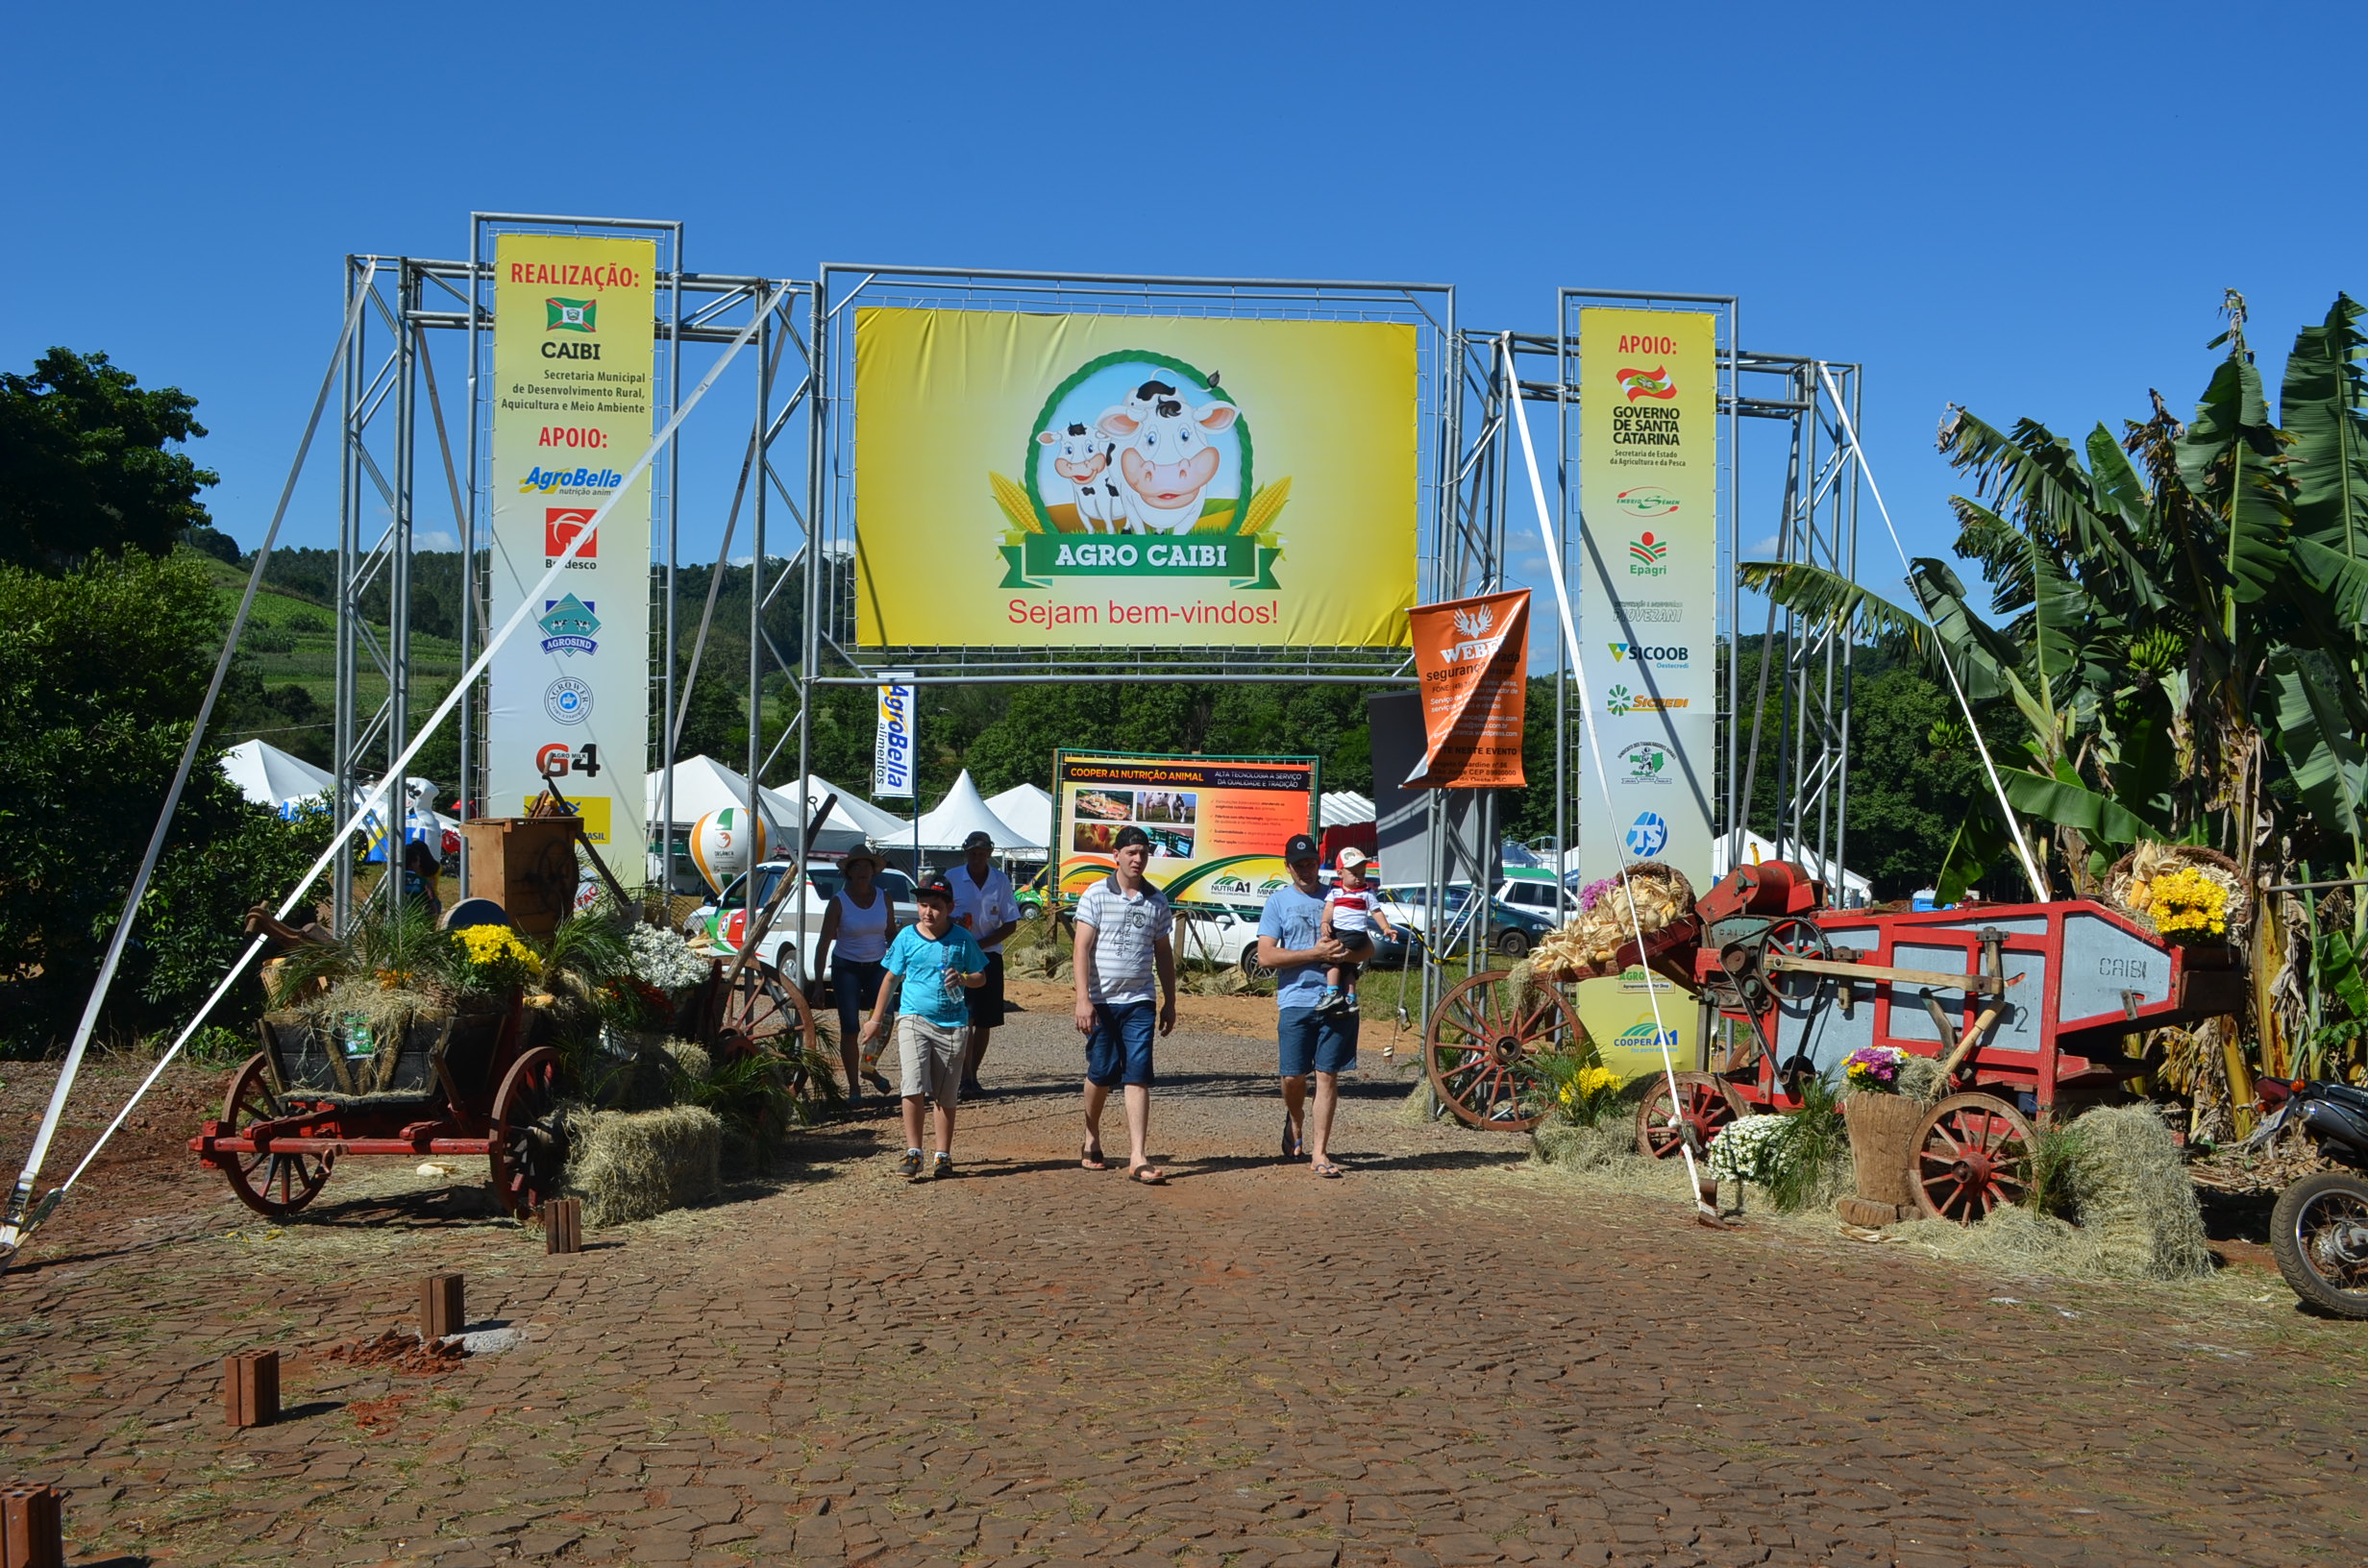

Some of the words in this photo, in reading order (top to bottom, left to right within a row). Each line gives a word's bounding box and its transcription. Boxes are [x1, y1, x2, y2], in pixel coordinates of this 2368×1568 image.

[510, 262, 640, 291] REALIZAÇÃO:
[541, 341, 601, 360] CAIBI
[1618, 334, 1677, 355] APOIO:
[544, 369, 595, 381] Secretaria
[597, 371, 646, 384] Municipal
[512, 383, 525, 393] de
[528, 383, 613, 397] Desenvolvimento
[615, 387, 645, 399] Rural,
[501, 399, 559, 410] Aquicultura
[562, 402, 568, 410] e
[571, 402, 595, 411] Meio
[597, 402, 645, 413] Ambiente
[1613, 406, 1680, 419] GOVERNO
[1613, 419, 1632, 431] DE
[1635, 420, 1680, 432] SANTA
[538, 427, 608, 449] APOIO:
[1613, 432, 1681, 446] CATARINA
[1615, 449, 1647, 457] Secretaria
[1618, 457, 1654, 466] Agricultura
[525, 467, 622, 490] AgroBella
[558, 488, 591, 497] nutrição
[1055, 544, 1139, 567] AGRO
[1147, 545, 1227, 568] CAIBI
[545, 559, 597, 570] Bdesco
[1630, 565, 1666, 576] Epagri
[1008, 600, 1098, 630] Sejam
[1108, 600, 1279, 625] bem-vindos!
[1613, 608, 1683, 623] PIOVEZANI
[547, 638, 592, 649] AGROSIND
[1440, 637, 1501, 664] WEBE
[1628, 647, 1689, 661] SICOOB
[884, 685, 909, 788] AgroBella
[876, 723, 887, 784] alimentos
[1486, 747, 1517, 755] EVENTO
[1071, 768, 1108, 777] COOPER
[1109, 770, 1120, 778] A1
[1121, 770, 1167, 782] NUTRIÇÃO
[1169, 772, 1204, 782] ANIMAL
[1632, 825, 1662, 847] TS
[1235, 882, 1250, 893] A1
[2099, 957, 2147, 980] CAIBI
[2014, 1006, 2029, 1033] 2
[1653, 1030, 1678, 1045] A1
